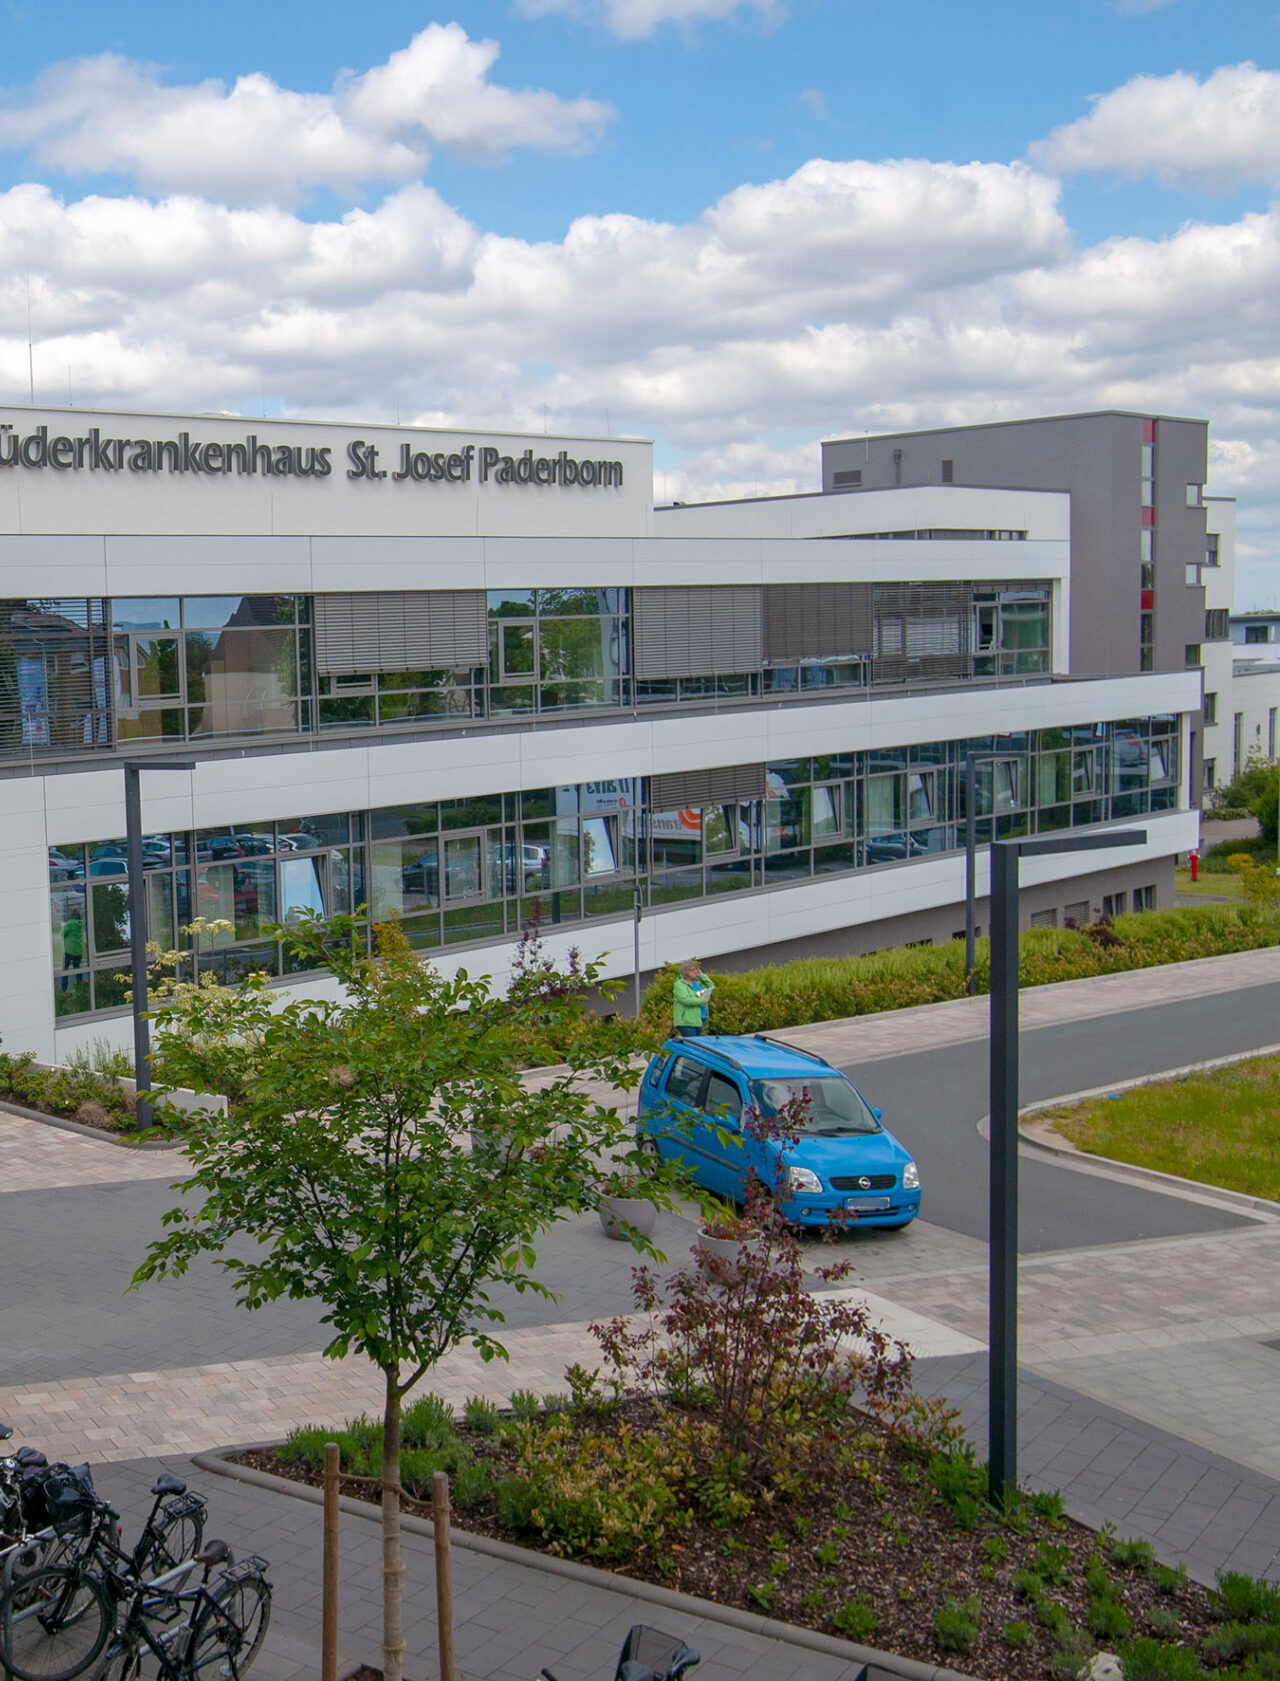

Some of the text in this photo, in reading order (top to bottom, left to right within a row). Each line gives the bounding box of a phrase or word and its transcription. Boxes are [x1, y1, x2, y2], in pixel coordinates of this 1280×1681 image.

[347, 440, 387, 480] St.
[392, 443, 475, 482] Josef
[478, 446, 625, 487] Paderborn
